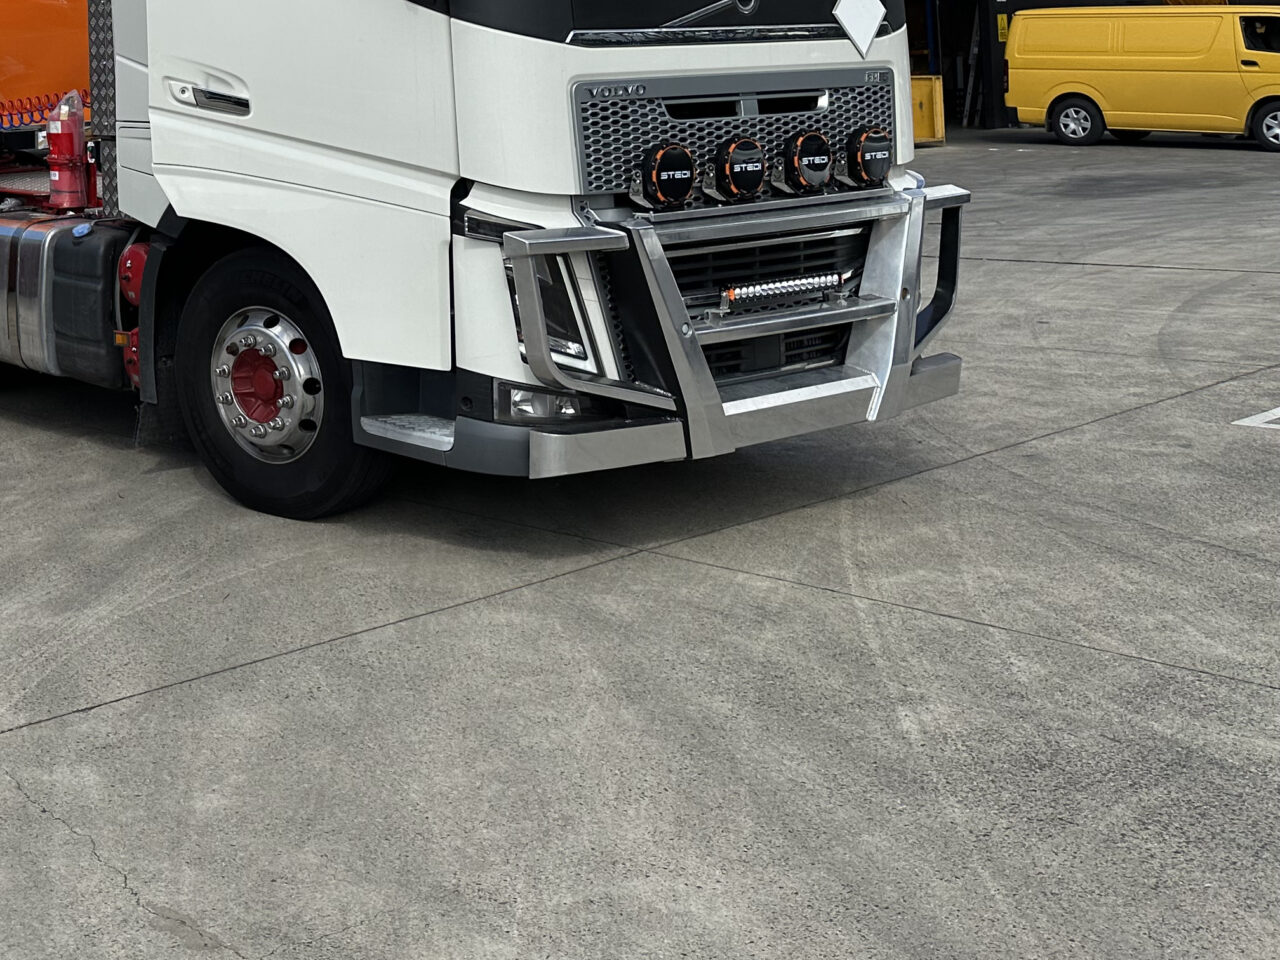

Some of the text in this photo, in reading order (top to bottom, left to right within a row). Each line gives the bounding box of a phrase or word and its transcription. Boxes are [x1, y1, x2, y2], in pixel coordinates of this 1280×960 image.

[584, 84, 646, 99] VOLVO
[801, 155, 828, 165] STEDI
[864, 151, 889, 160] STEDI
[733, 162, 762, 172] STEDI
[660, 170, 691, 180] STEDI
